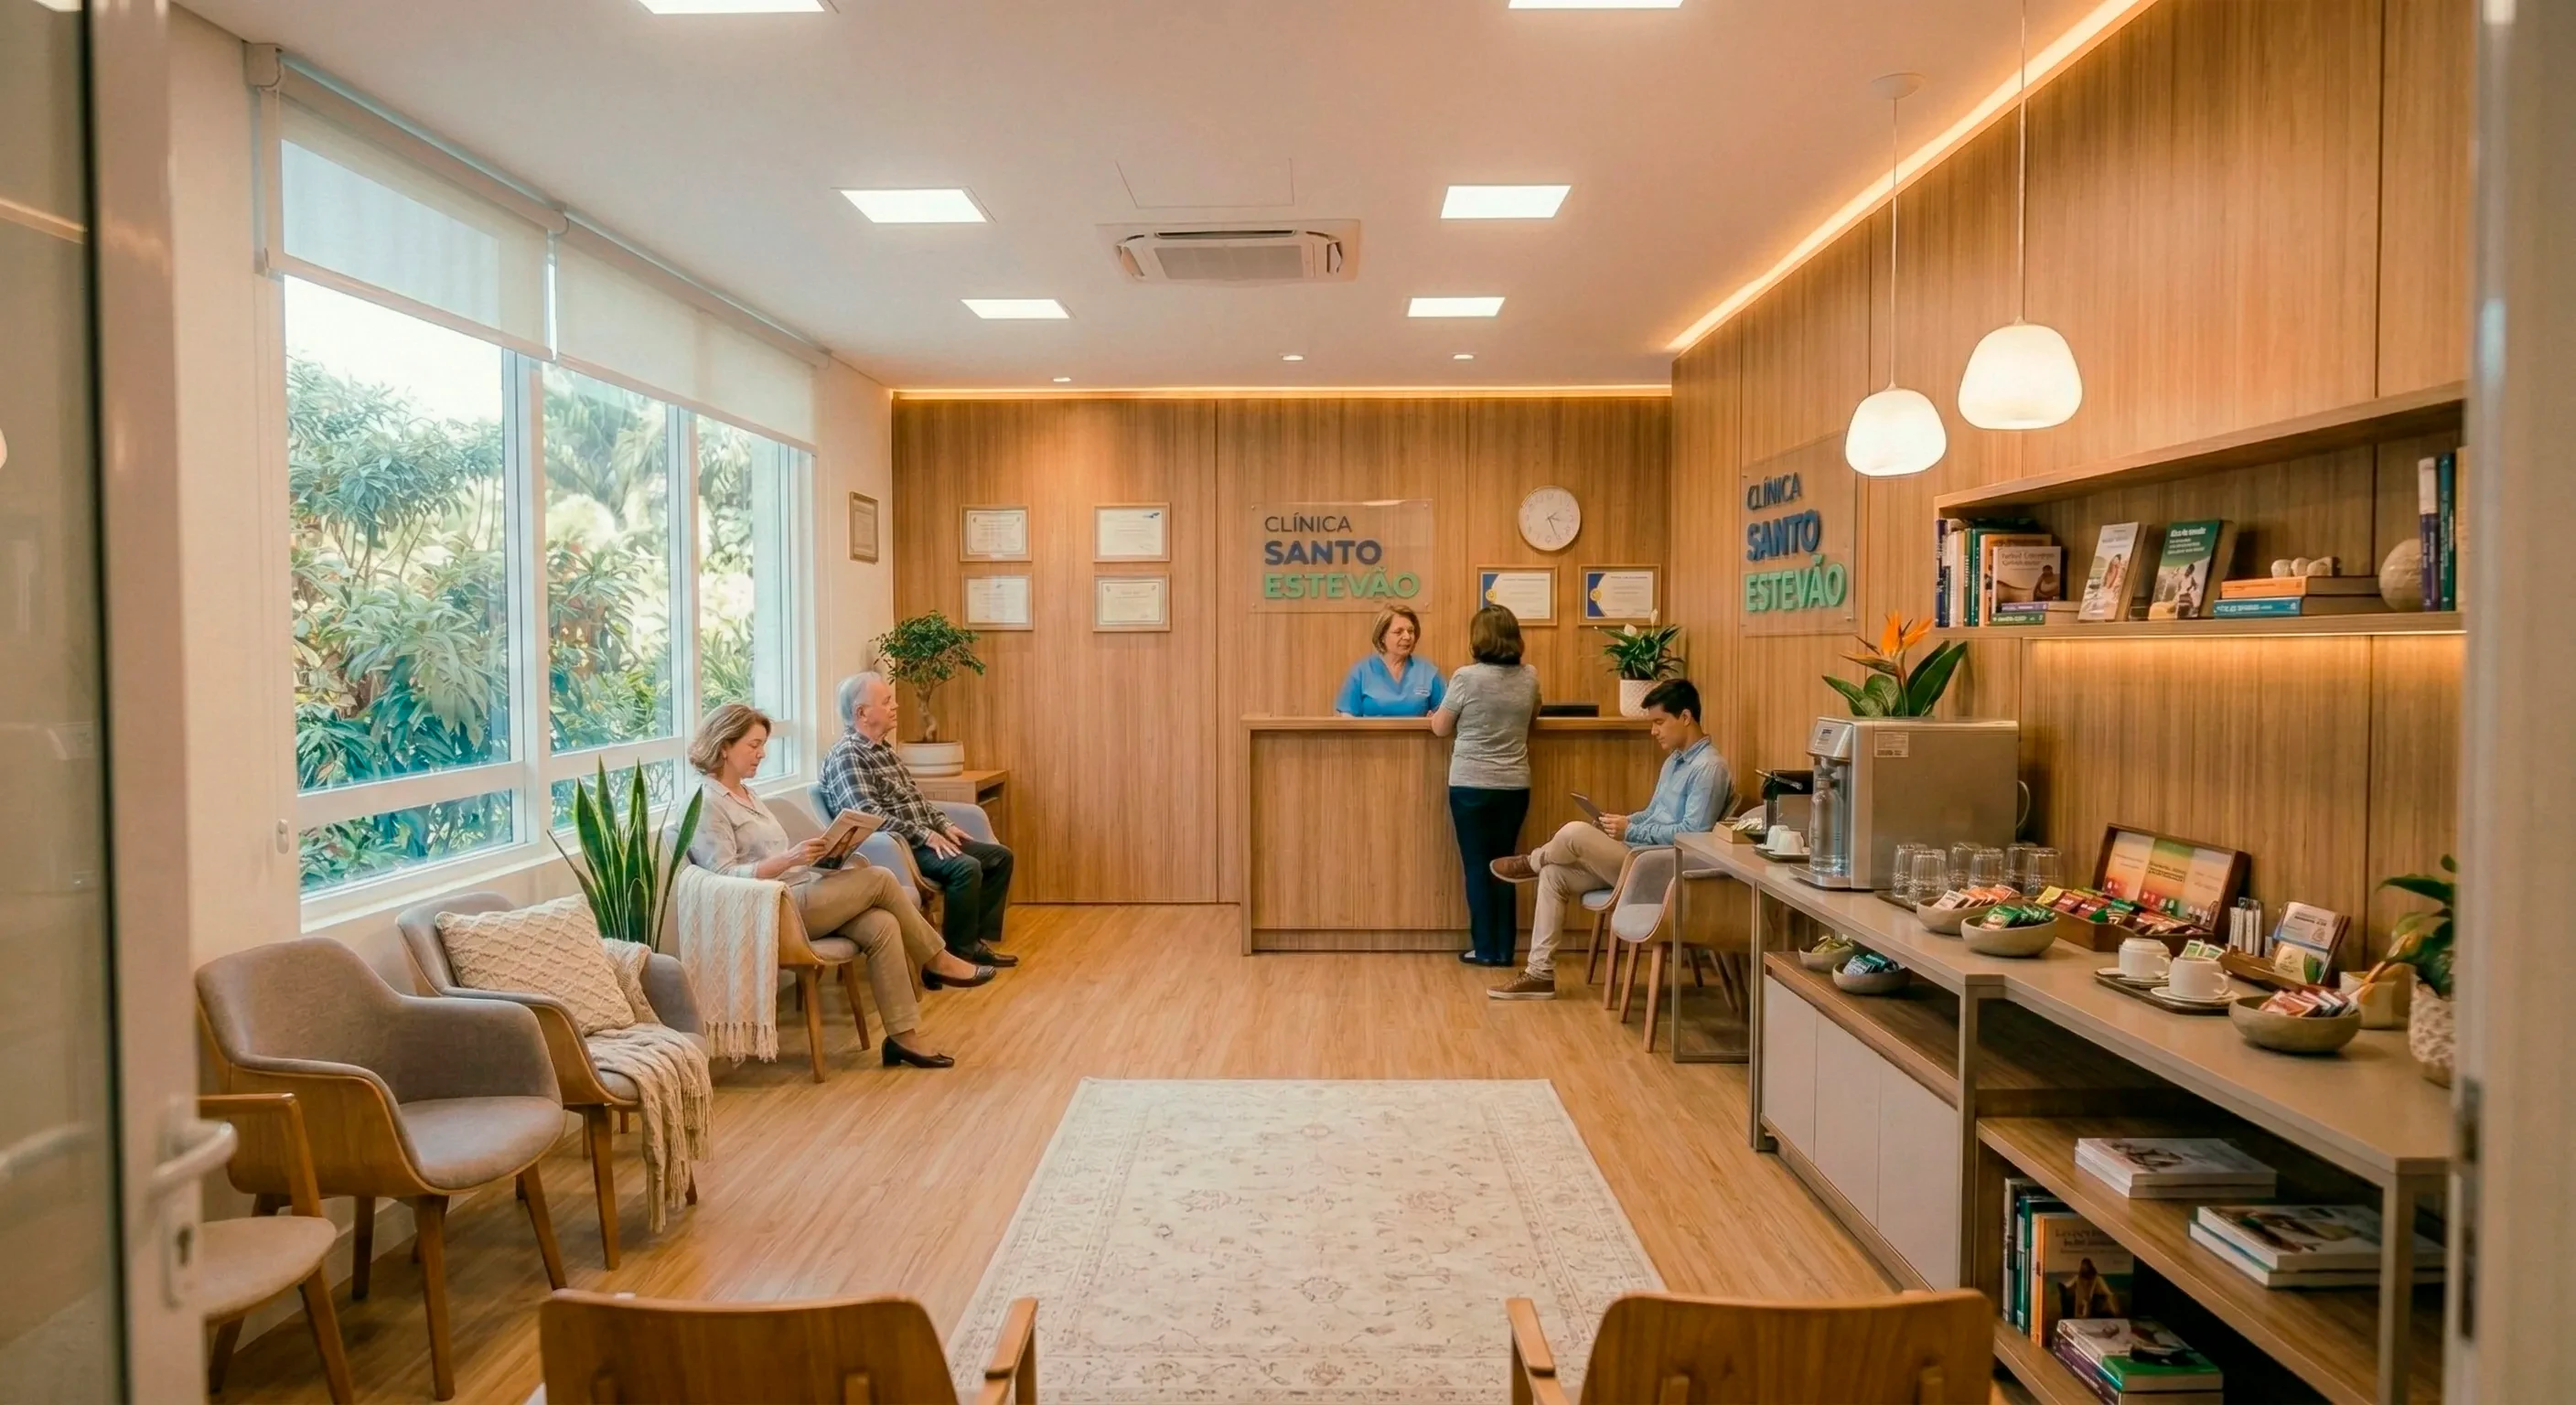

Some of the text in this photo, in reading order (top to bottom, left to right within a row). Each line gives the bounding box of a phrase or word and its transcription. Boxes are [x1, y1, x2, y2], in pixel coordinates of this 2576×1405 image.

[1747, 472, 1802, 510] CLÍNICA
[1264, 512, 1352, 532] CLÍNICA
[1746, 509, 1821, 562] SANTO
[1264, 540, 1382, 565] SANTO
[1264, 566, 1421, 599] ESTEVÃO
[1745, 553, 1846, 612] ESTEVÃO
